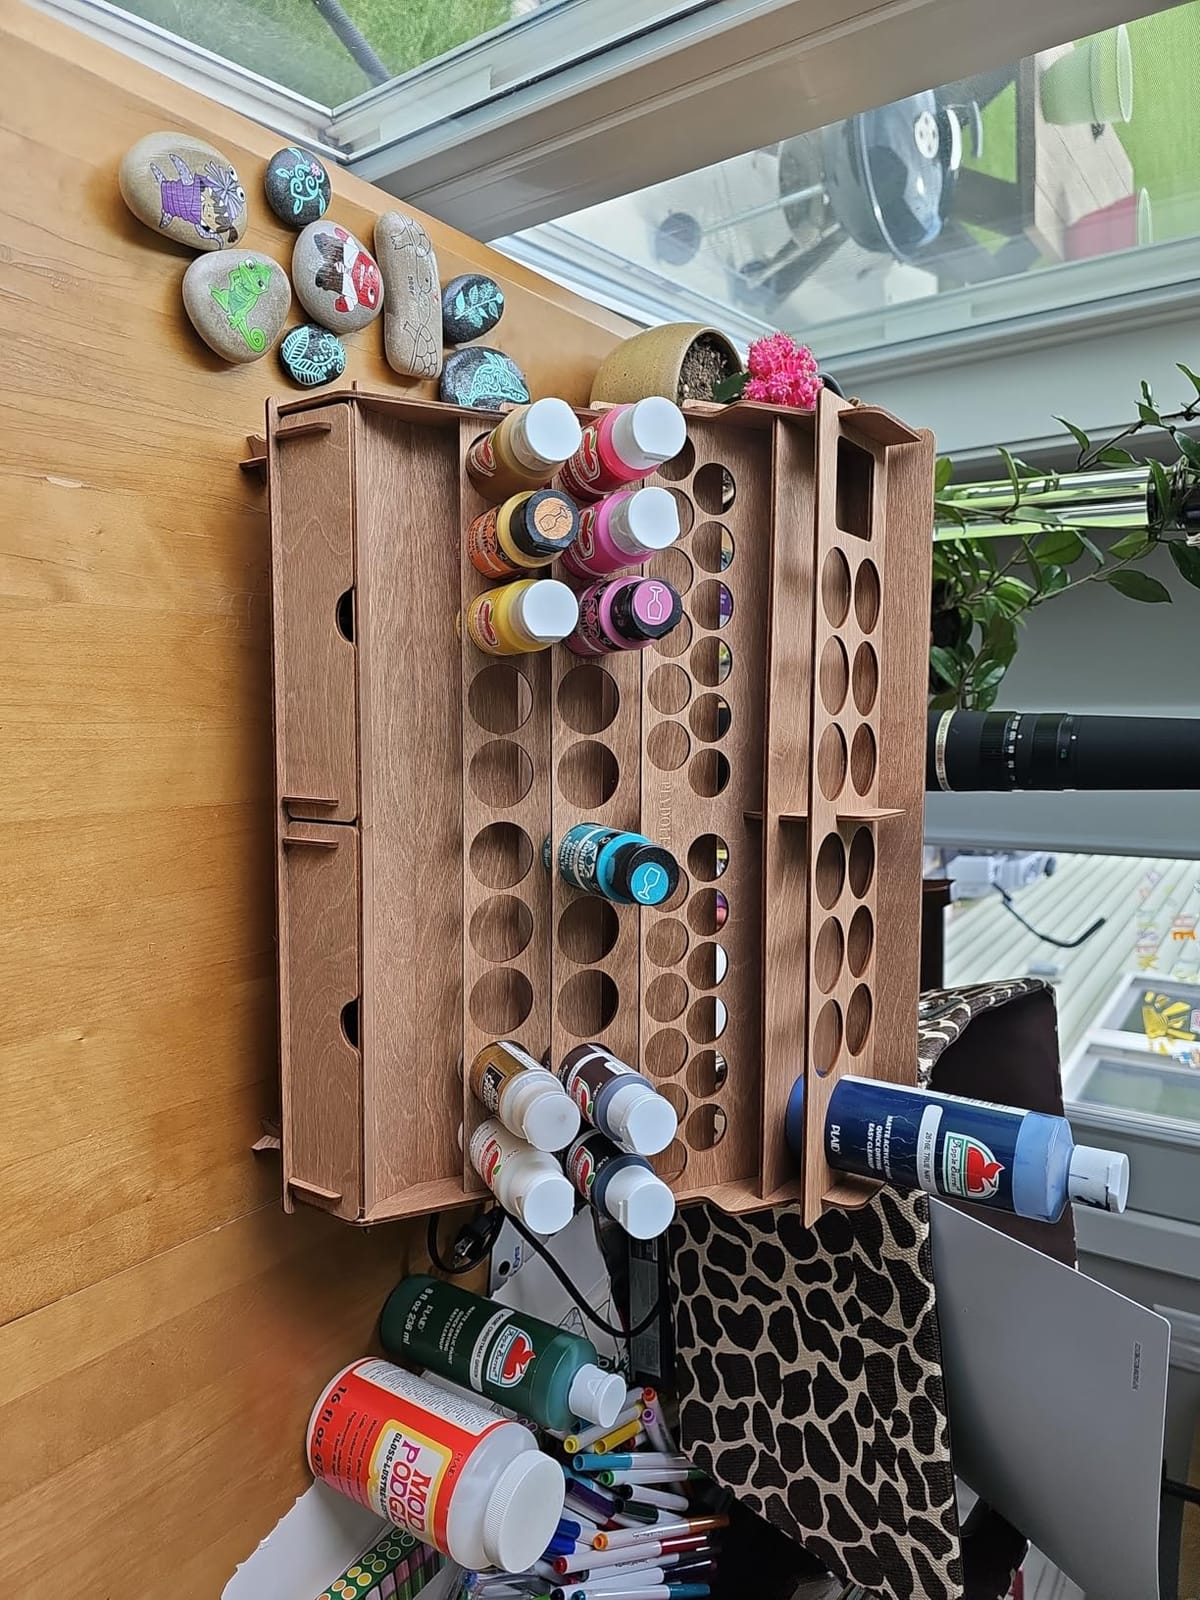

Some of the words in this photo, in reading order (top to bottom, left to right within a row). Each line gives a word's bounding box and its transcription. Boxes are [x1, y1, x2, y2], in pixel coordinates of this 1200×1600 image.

[866, 1122, 876, 1140] EASY
[875, 1124, 883, 1143] QUICK
[883, 1114, 894, 1137] MATTE
[830, 1124, 841, 1153] PLAID
[882, 1137, 892, 1164] ACRYLIC
[923, 1151, 932, 1168] TRUE
[950, 1138, 962, 1163] Apple
[411, 1300, 422, 1312] oz
[419, 1293, 429, 1301] fl
[404, 1312, 417, 1331] 236
[417, 1304, 434, 1330] PLAID
[402, 1331, 411, 1345] ml
[477, 1326, 494, 1359] CHRISTMAS
[331, 1385, 348, 1404] 16
[322, 1408, 334, 1424] fl
[315, 1426, 325, 1447] oz
[389, 1439, 421, 1529] PODGE
[407, 1468, 432, 1532] MOD
